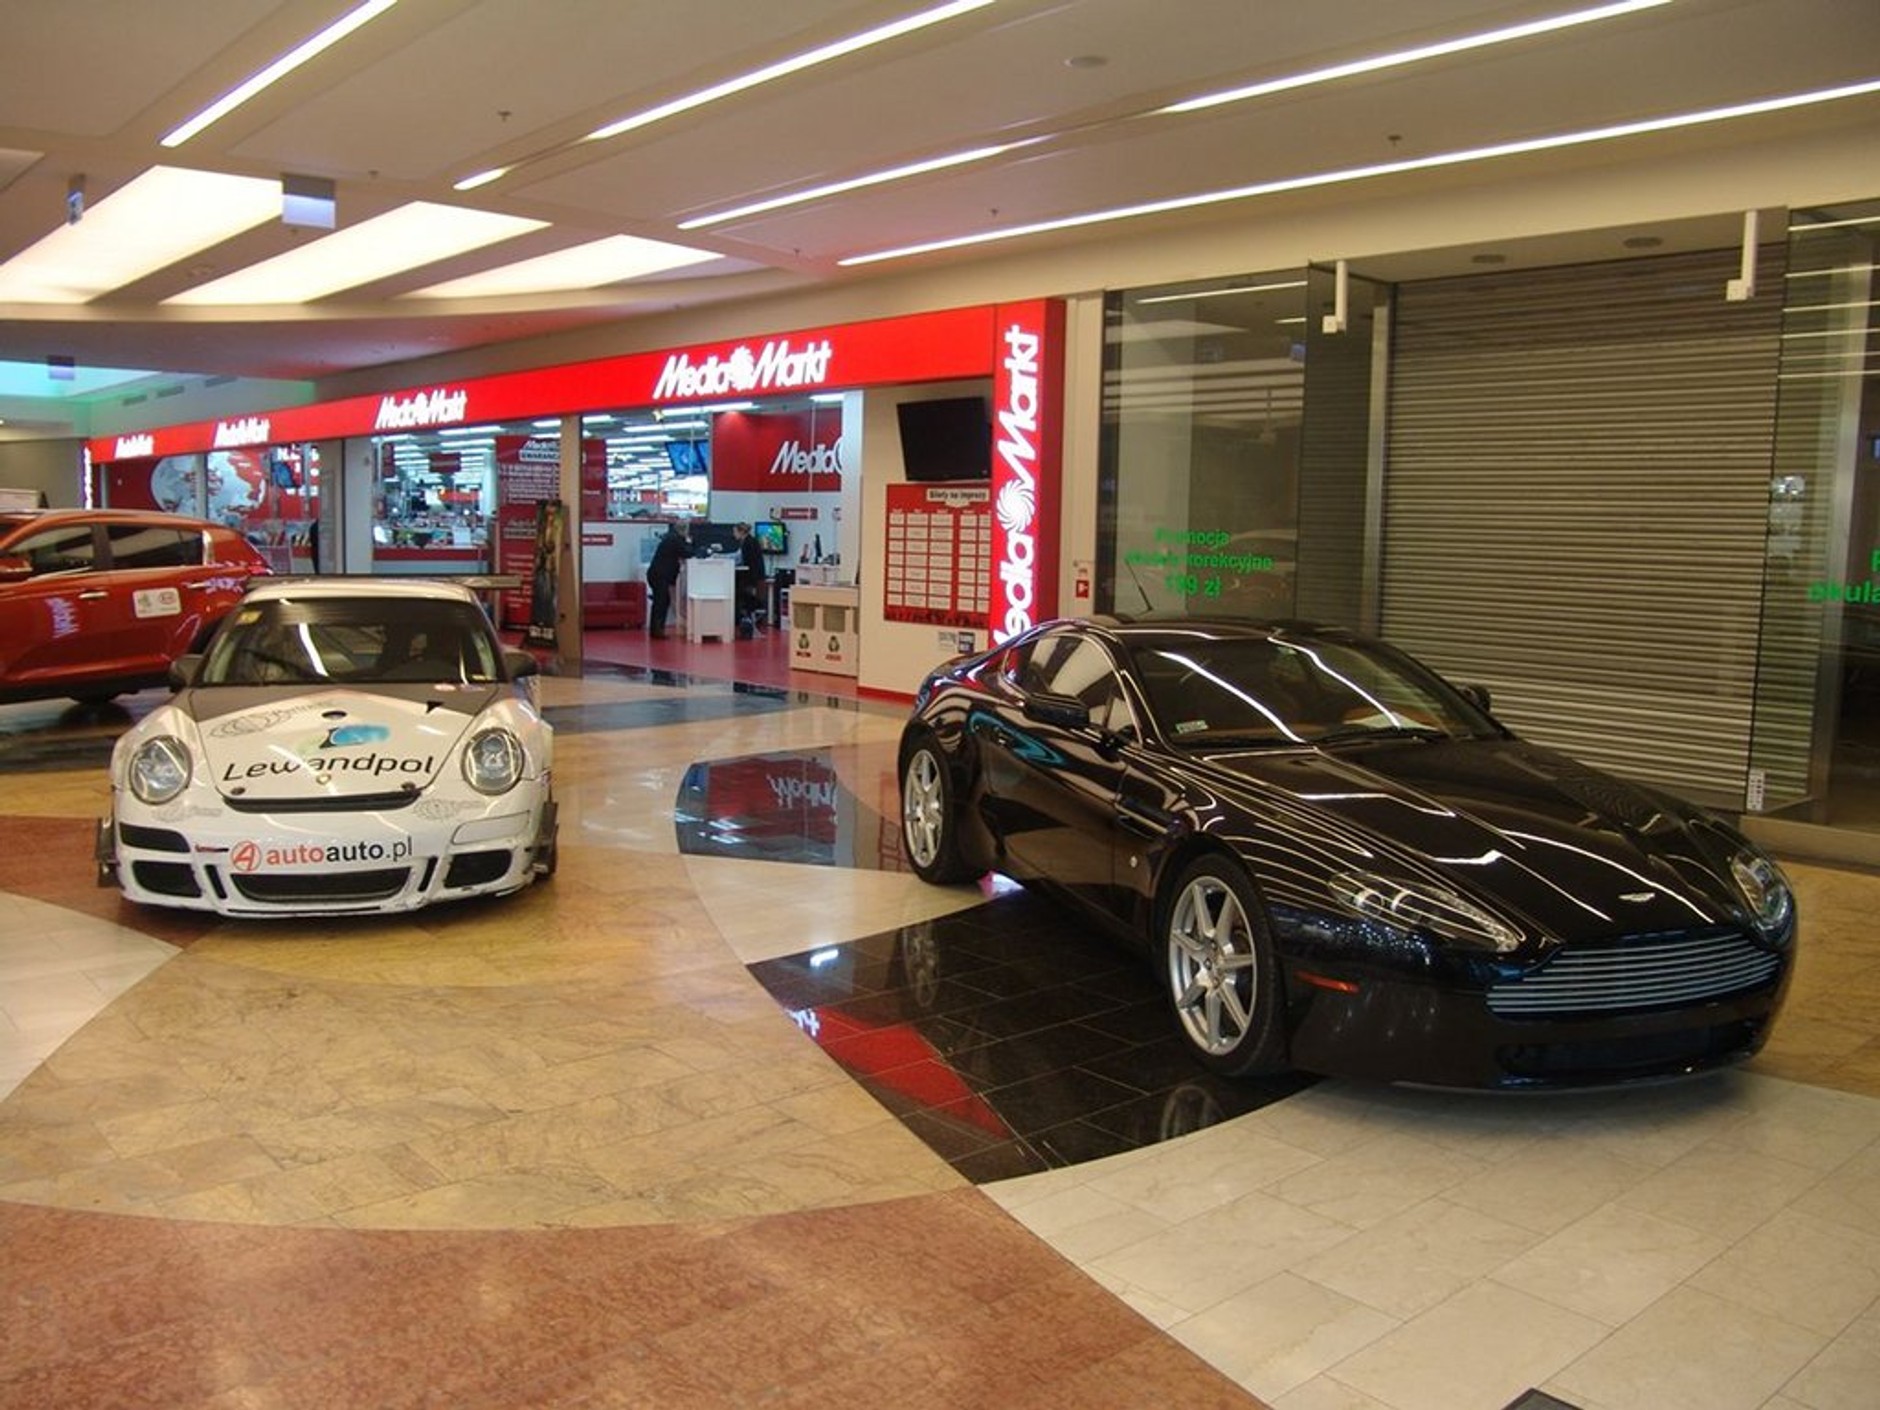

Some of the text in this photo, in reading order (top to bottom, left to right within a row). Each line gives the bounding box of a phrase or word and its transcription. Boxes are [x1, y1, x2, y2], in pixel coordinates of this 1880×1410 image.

[653, 340, 833, 400] Media Markt
[770, 441, 836, 474] Media
[222, 753, 434, 782] Lewandpol
[266, 836, 413, 866] autoauto.pl
